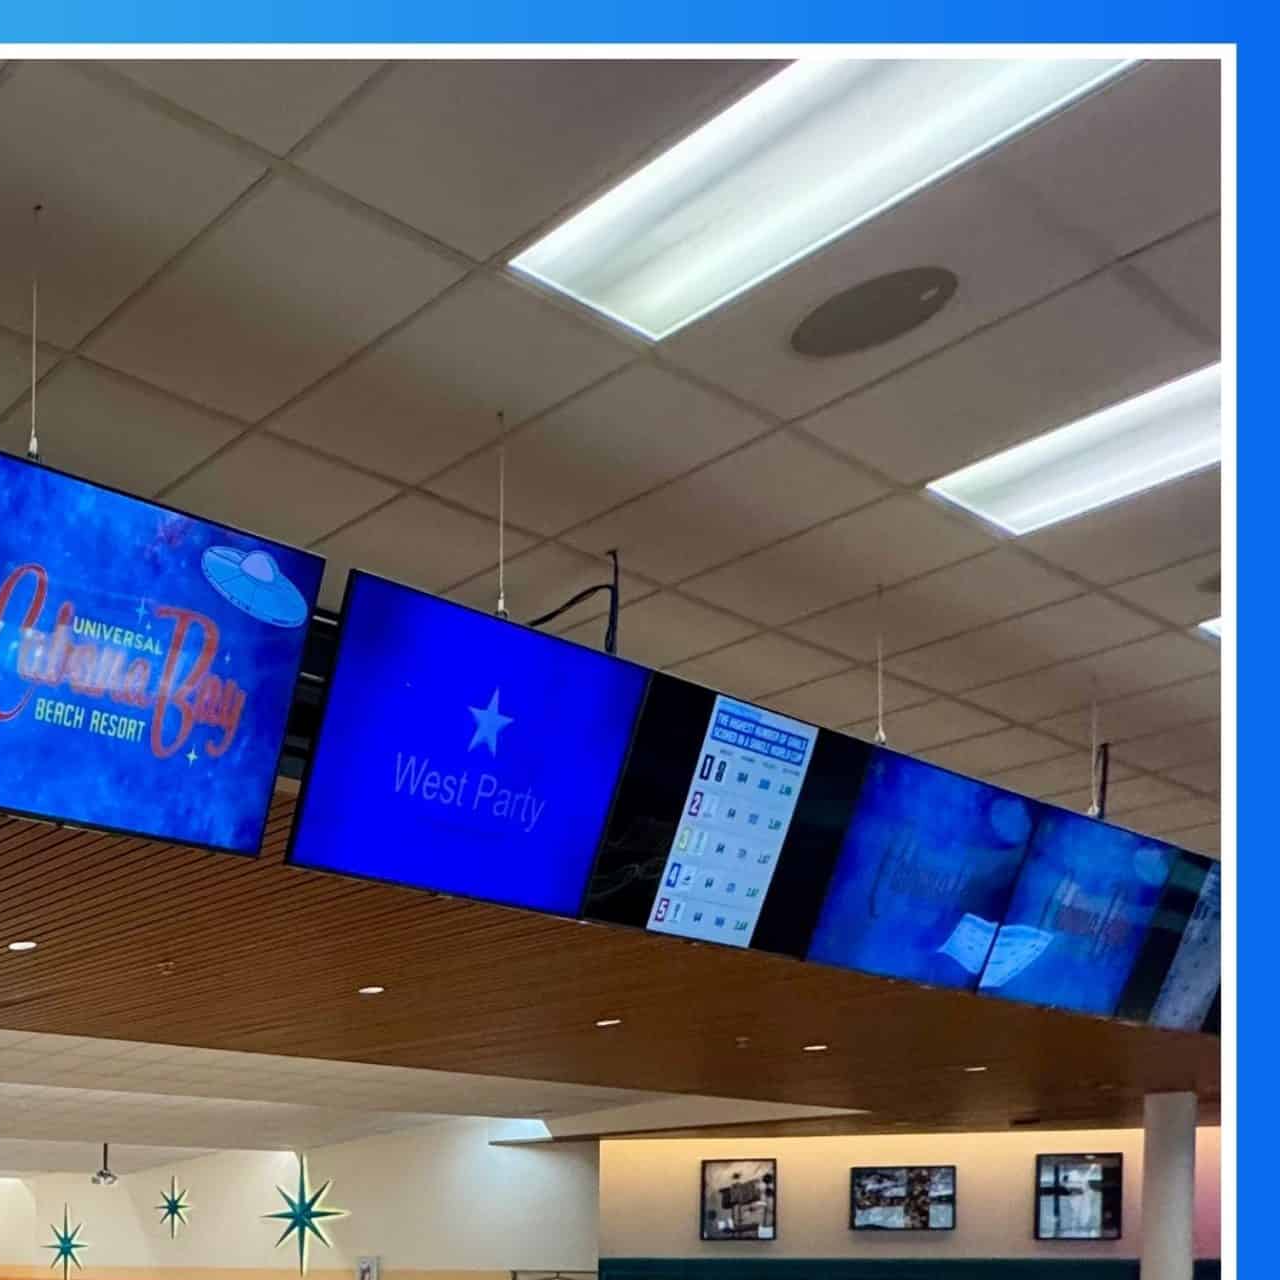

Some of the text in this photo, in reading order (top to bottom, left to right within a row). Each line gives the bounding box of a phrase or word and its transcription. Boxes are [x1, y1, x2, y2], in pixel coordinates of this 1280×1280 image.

[72, 615, 163, 656] UNIVERSAL
[34, 697, 147, 742] BEACH RESORT
[393, 751, 546, 833] West Party
